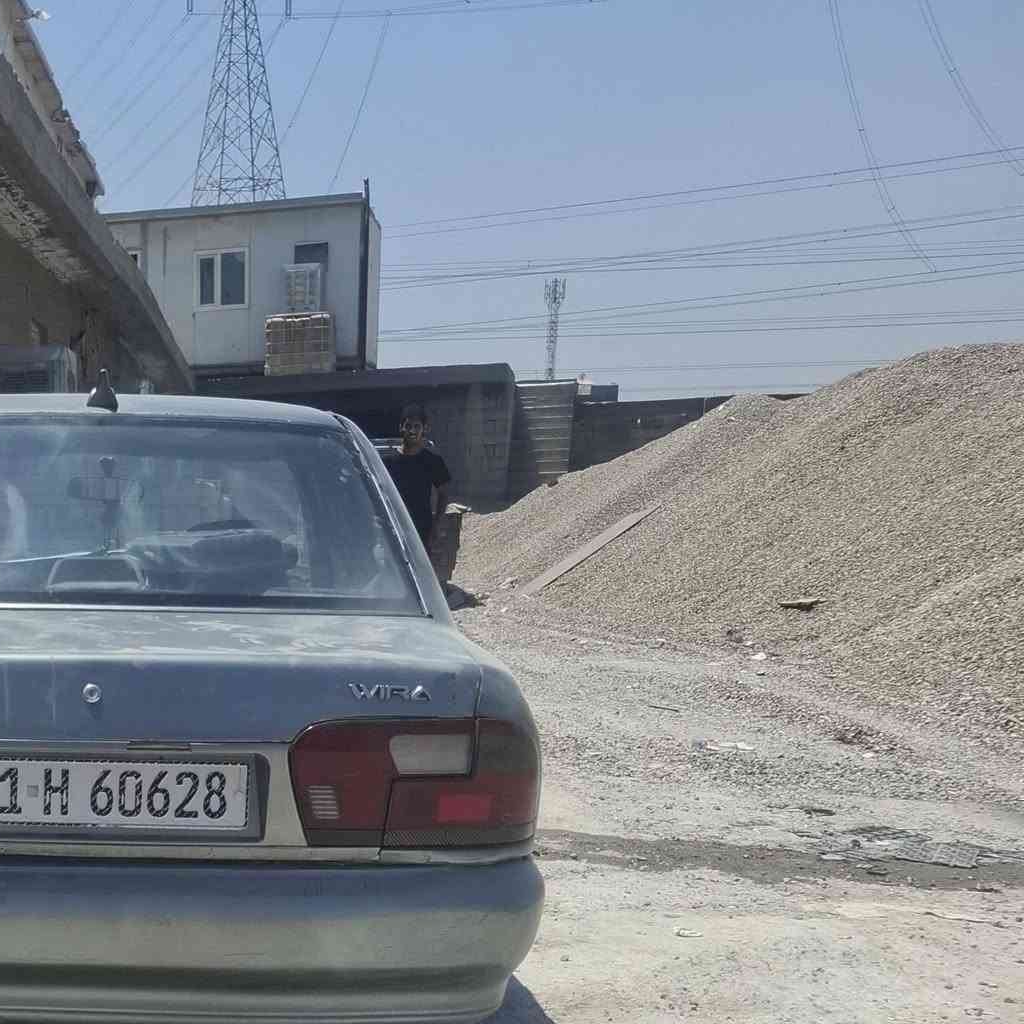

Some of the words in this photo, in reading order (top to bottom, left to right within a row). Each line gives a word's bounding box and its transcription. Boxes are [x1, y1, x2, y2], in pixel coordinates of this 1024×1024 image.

[347, 682, 432, 702] WIRA
[42, 767, 70, 816] H
[89, 769, 228, 820] 60628
